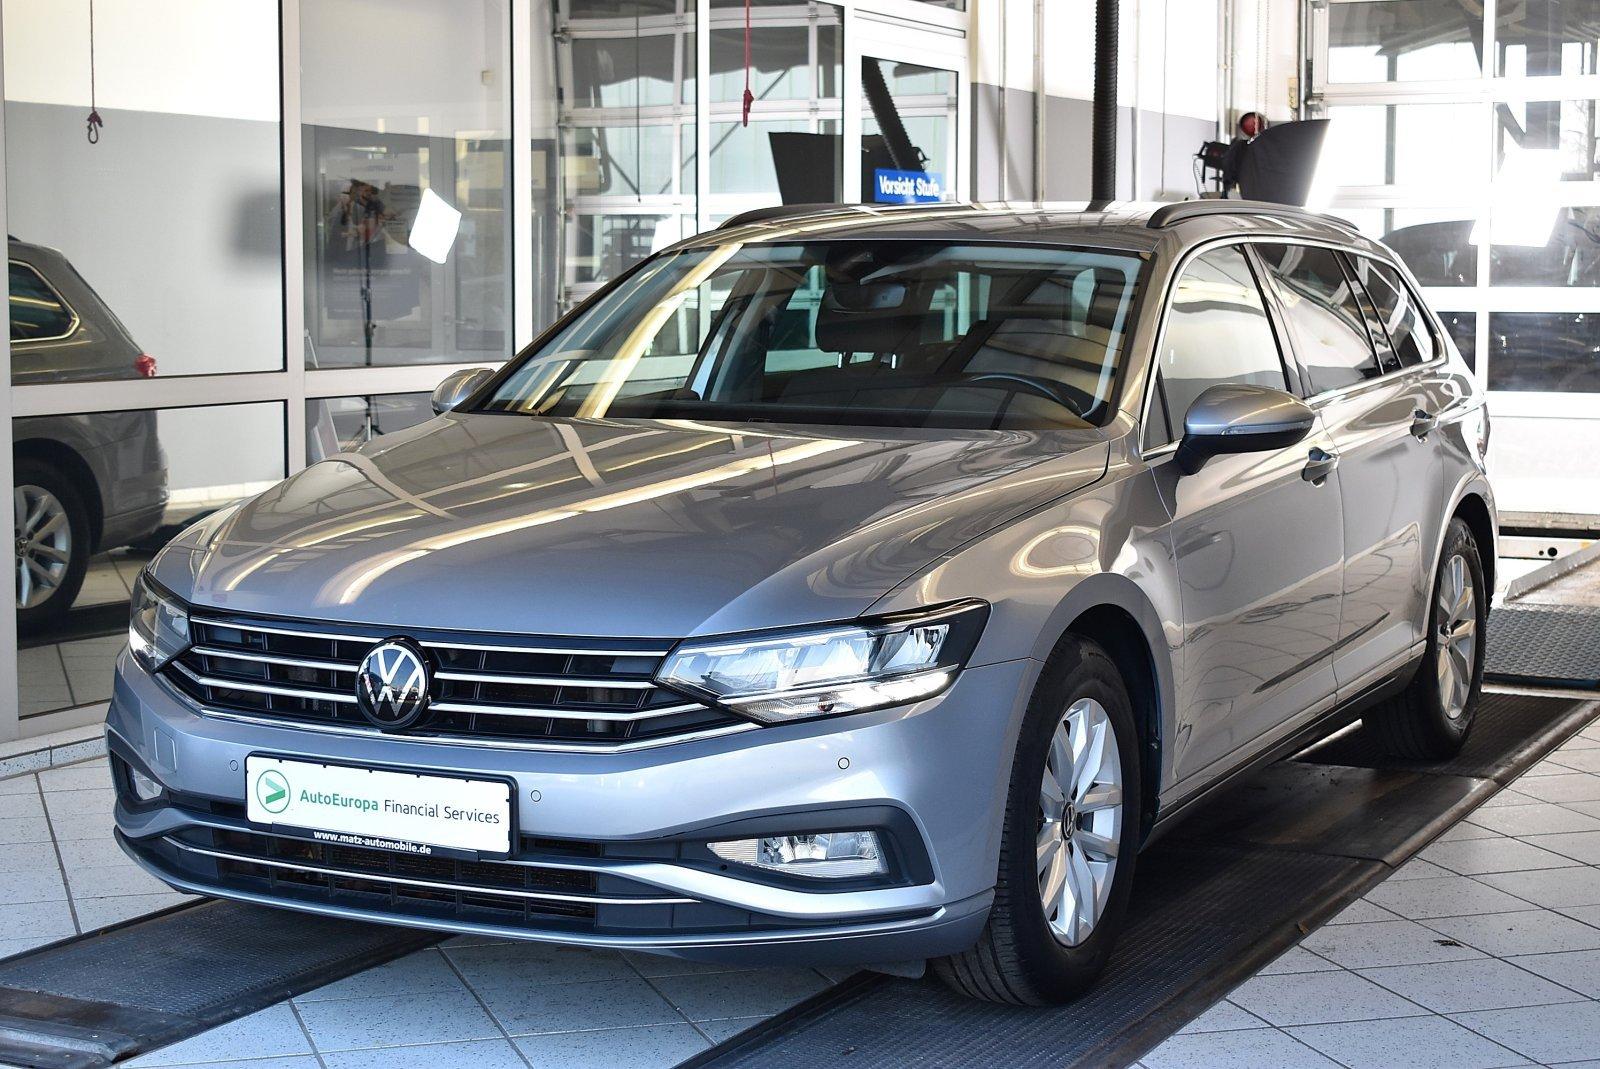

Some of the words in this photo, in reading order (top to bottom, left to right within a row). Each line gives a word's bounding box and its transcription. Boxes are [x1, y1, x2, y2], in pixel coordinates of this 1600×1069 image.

[878, 174, 915, 196] Vorsicht
[916, 177, 940, 198] Stufe
[359, 643, 426, 722] VW
[299, 789, 379, 812] AutoEuropa
[384, 799, 439, 818] Financial
[444, 806, 500, 824] Services
[313, 830, 432, 855] www.matz-automobile.de
